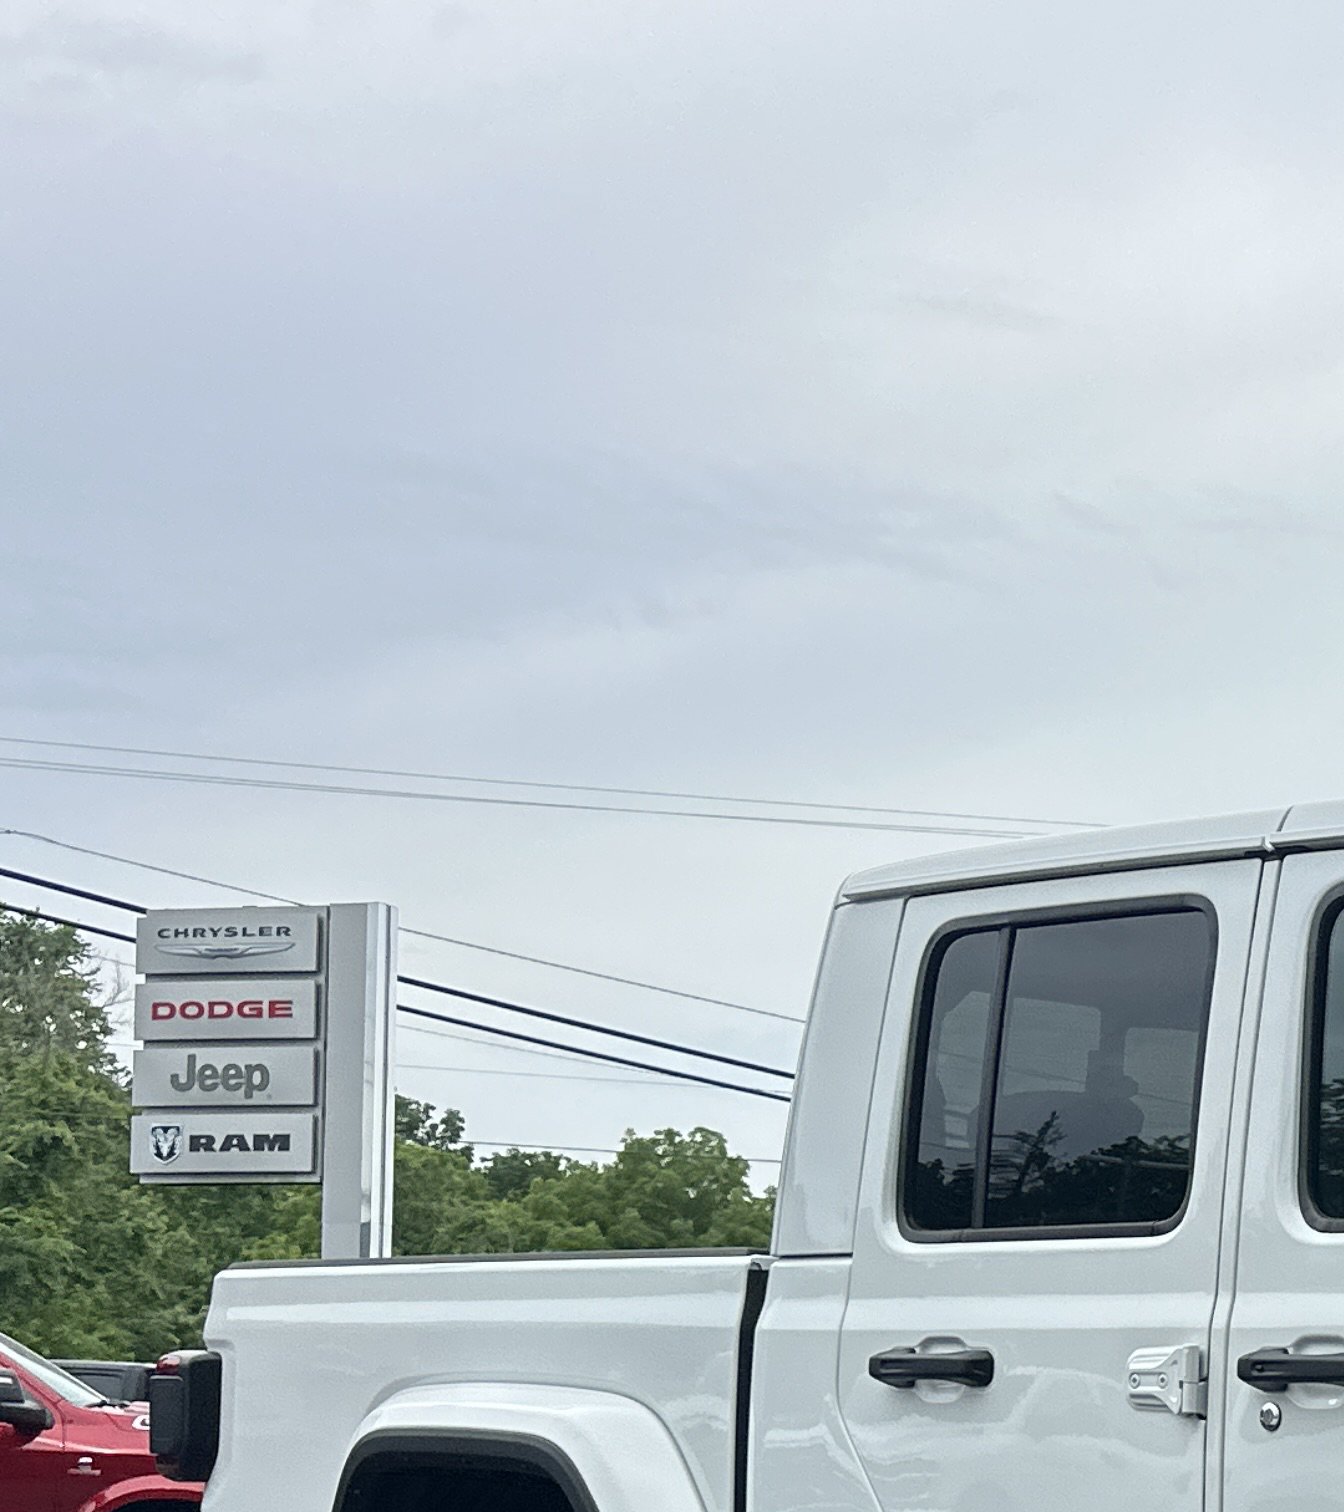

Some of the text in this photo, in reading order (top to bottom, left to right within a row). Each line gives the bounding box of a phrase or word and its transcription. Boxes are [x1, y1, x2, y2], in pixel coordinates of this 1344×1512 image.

[157, 925, 292, 939] CHRYSLER
[151, 1000, 293, 1021] DODGE
[170, 1054, 270, 1099] Jeep
[189, 1134, 290, 1152] RAM
